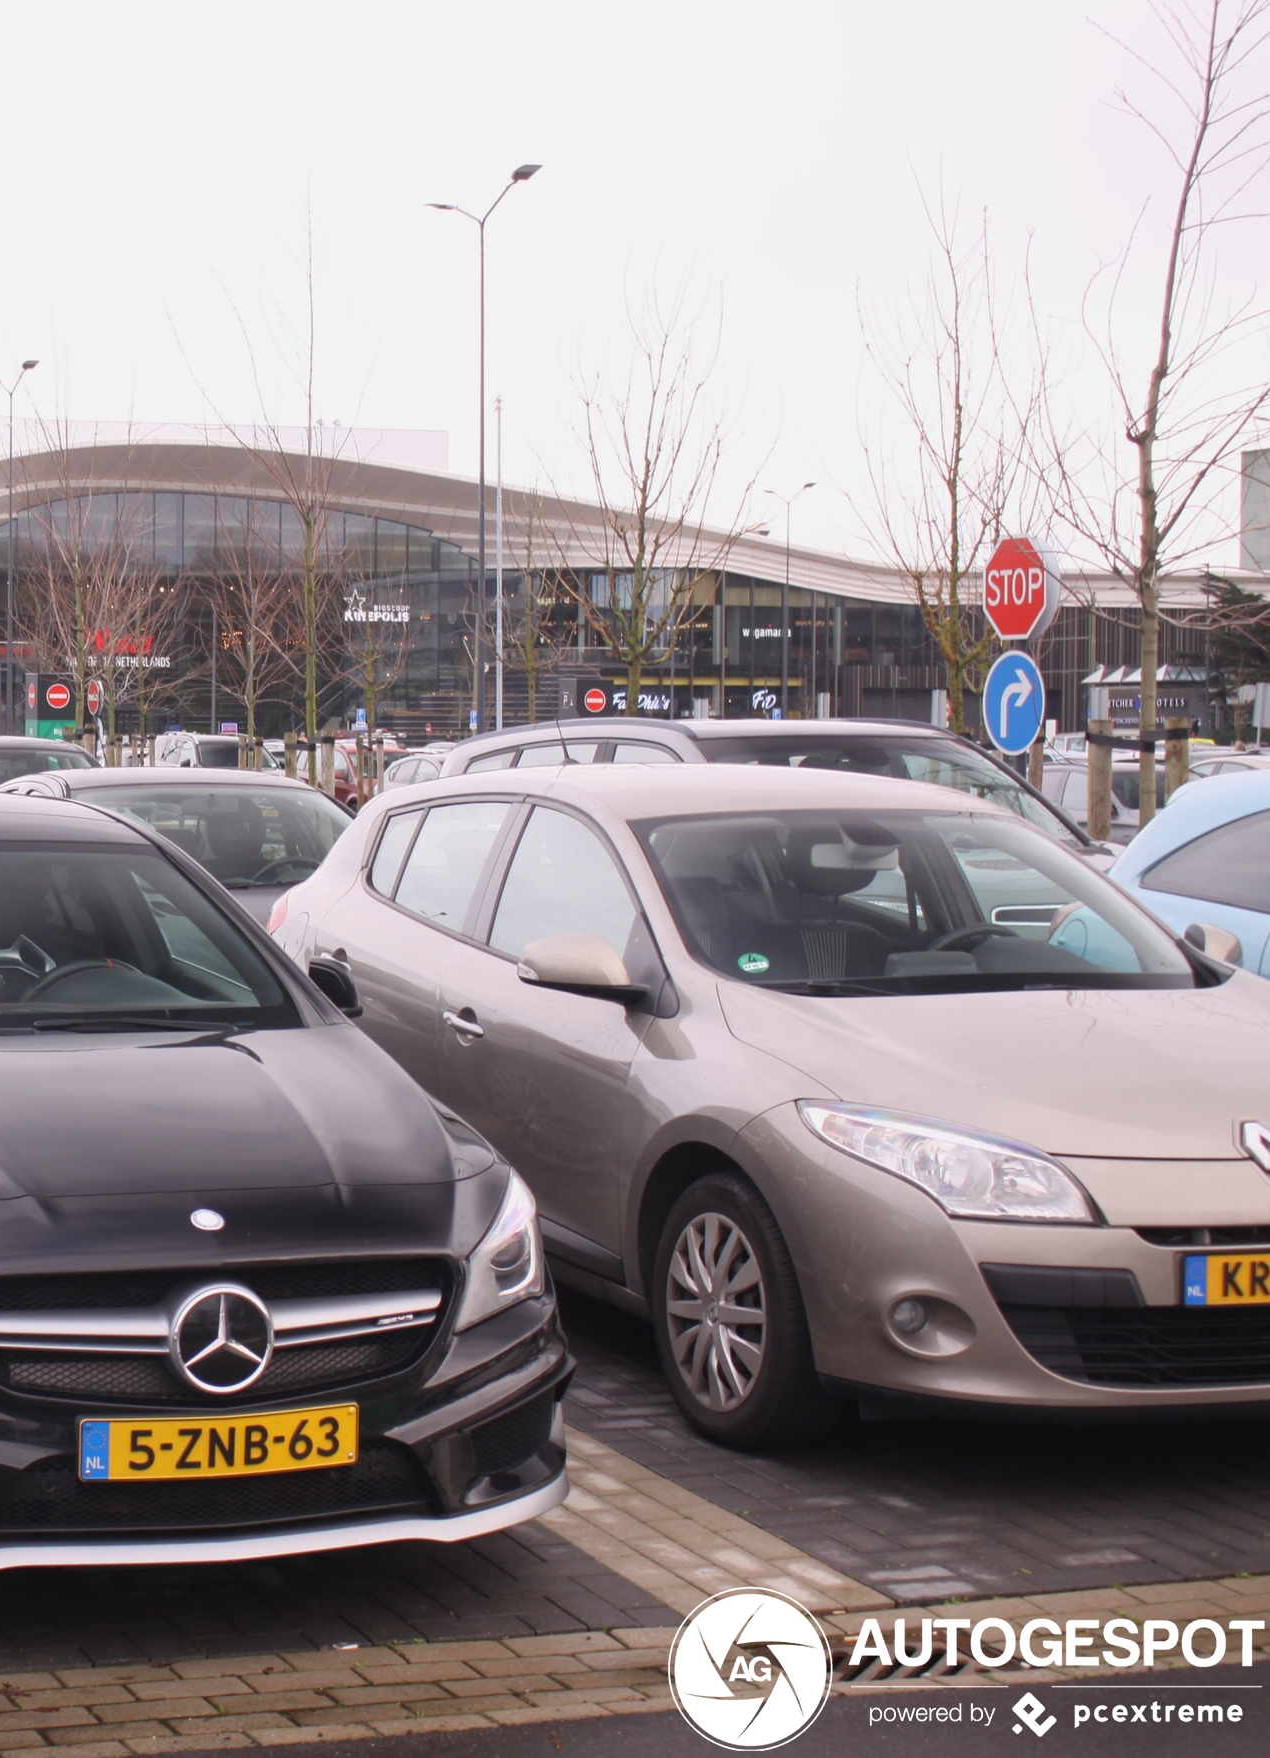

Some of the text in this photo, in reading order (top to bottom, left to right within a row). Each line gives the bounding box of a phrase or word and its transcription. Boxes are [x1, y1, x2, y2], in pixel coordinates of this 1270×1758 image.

[987, 568, 1043, 607] STOP
[373, 604, 411, 612] BIOSCOOP
[343, 610, 411, 623] KINEPOLIS
[1108, 698, 1185, 708] ETCHER OTELS
[1187, 1286, 1204, 1297] NL
[128, 1416, 340, 1471] 5-ZNB-63
[86, 1456, 105, 1470] NL
